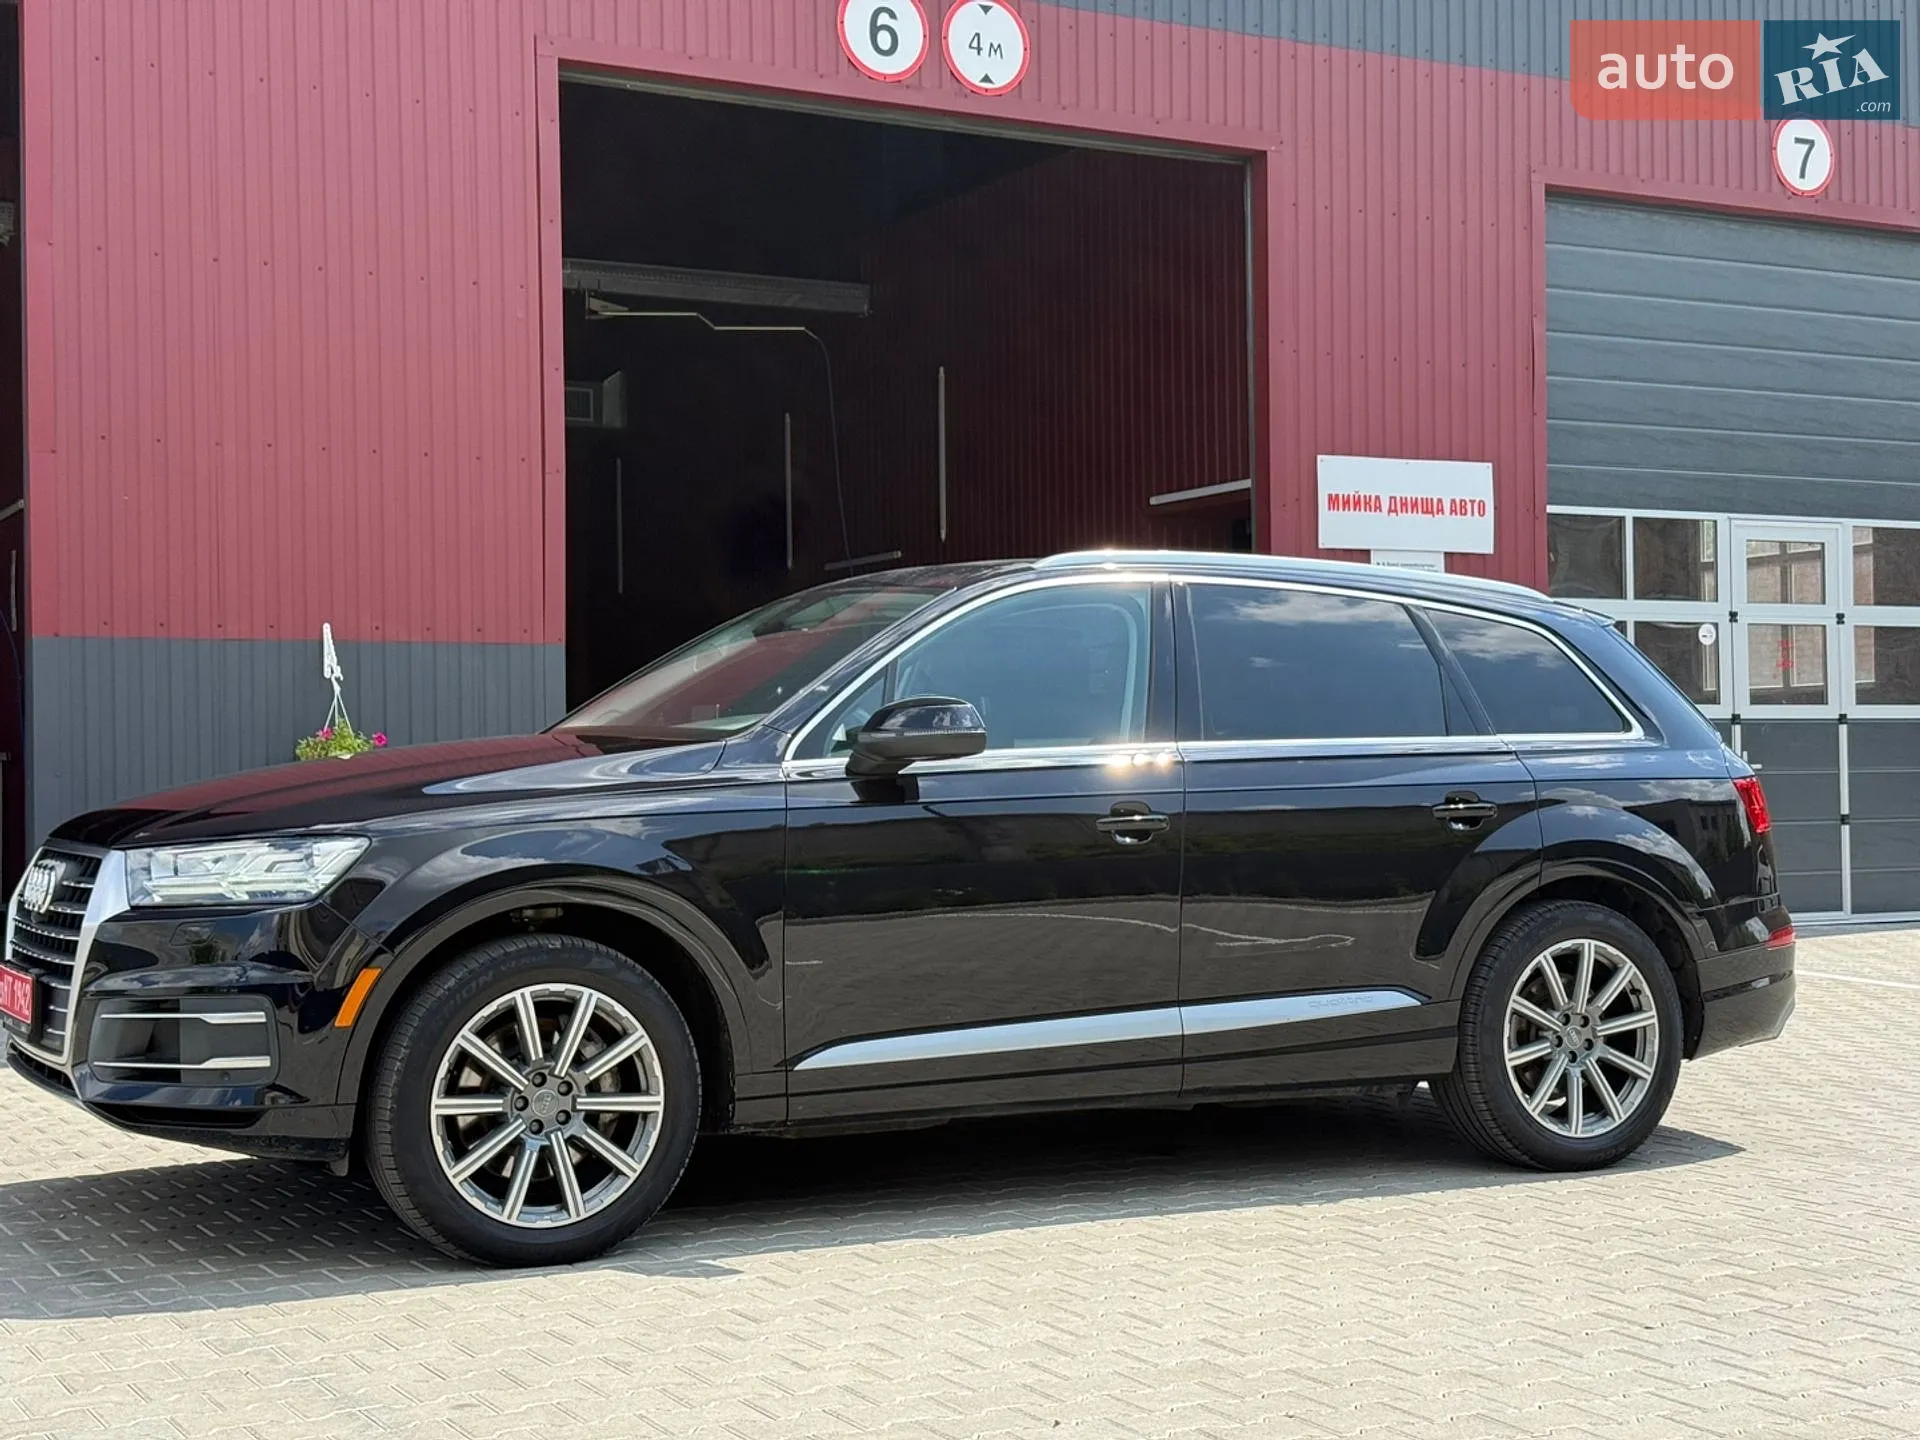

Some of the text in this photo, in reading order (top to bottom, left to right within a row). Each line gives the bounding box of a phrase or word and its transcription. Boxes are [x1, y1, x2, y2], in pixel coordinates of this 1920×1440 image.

[869, 6, 899, 57] 6
[968, 32, 983, 56] 4
[1794, 137, 1816, 179] 7
[1327, 490, 1486, 518] МИЙКА ДНИЩА АВТО
